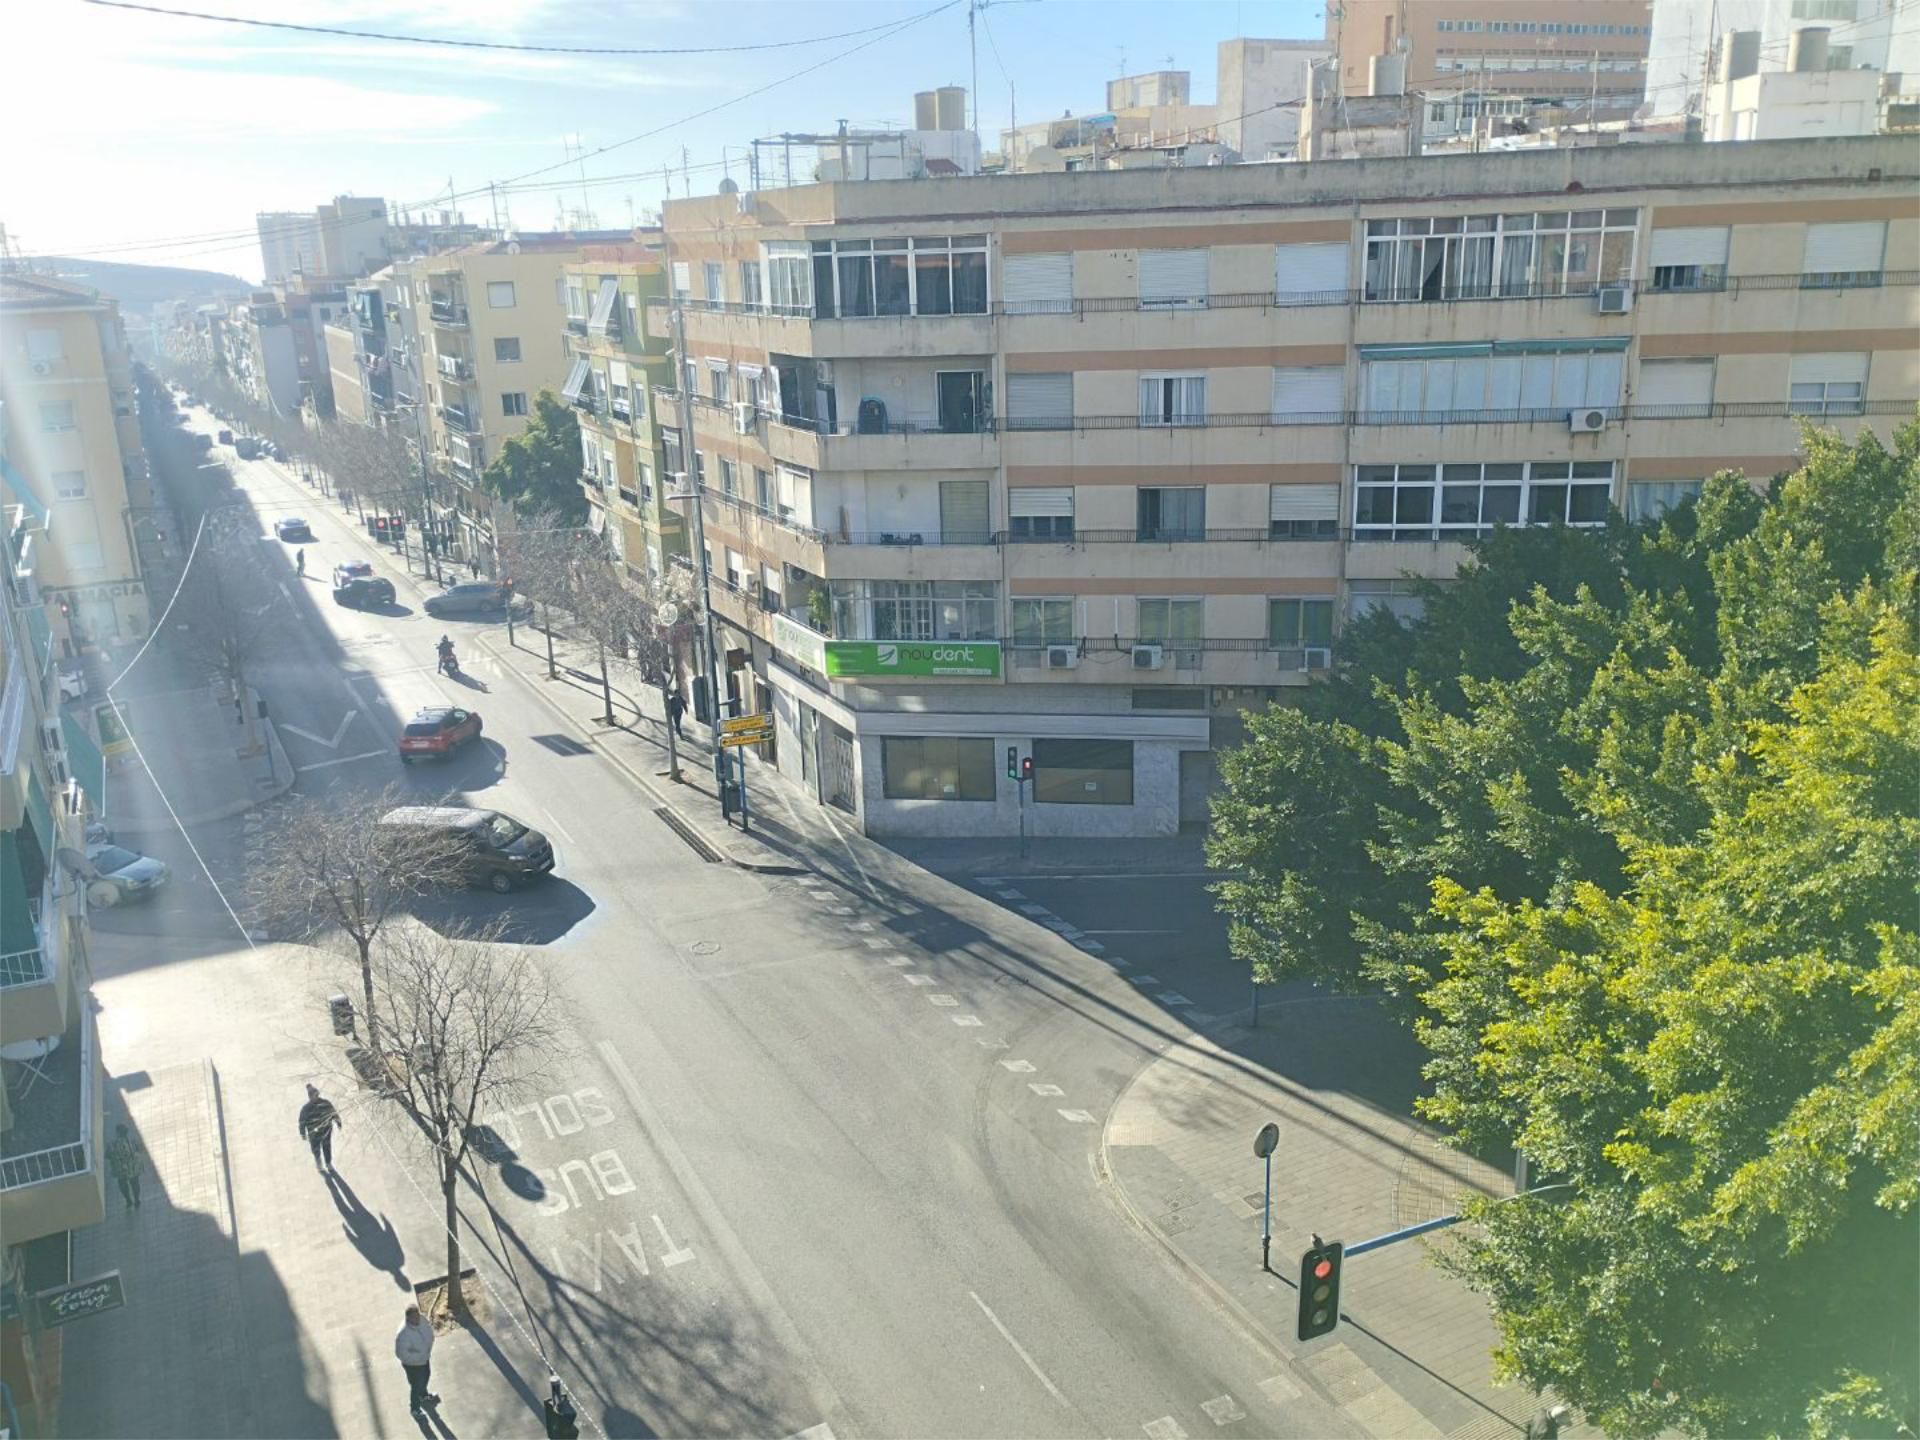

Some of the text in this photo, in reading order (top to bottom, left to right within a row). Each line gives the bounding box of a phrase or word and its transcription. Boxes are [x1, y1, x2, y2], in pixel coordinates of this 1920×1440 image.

[43, 583, 143, 605] FARMACIA
[899, 645, 974, 663] noudent
[531, 1148, 637, 1217] BUS
[550, 1213, 696, 1300] TAXI
